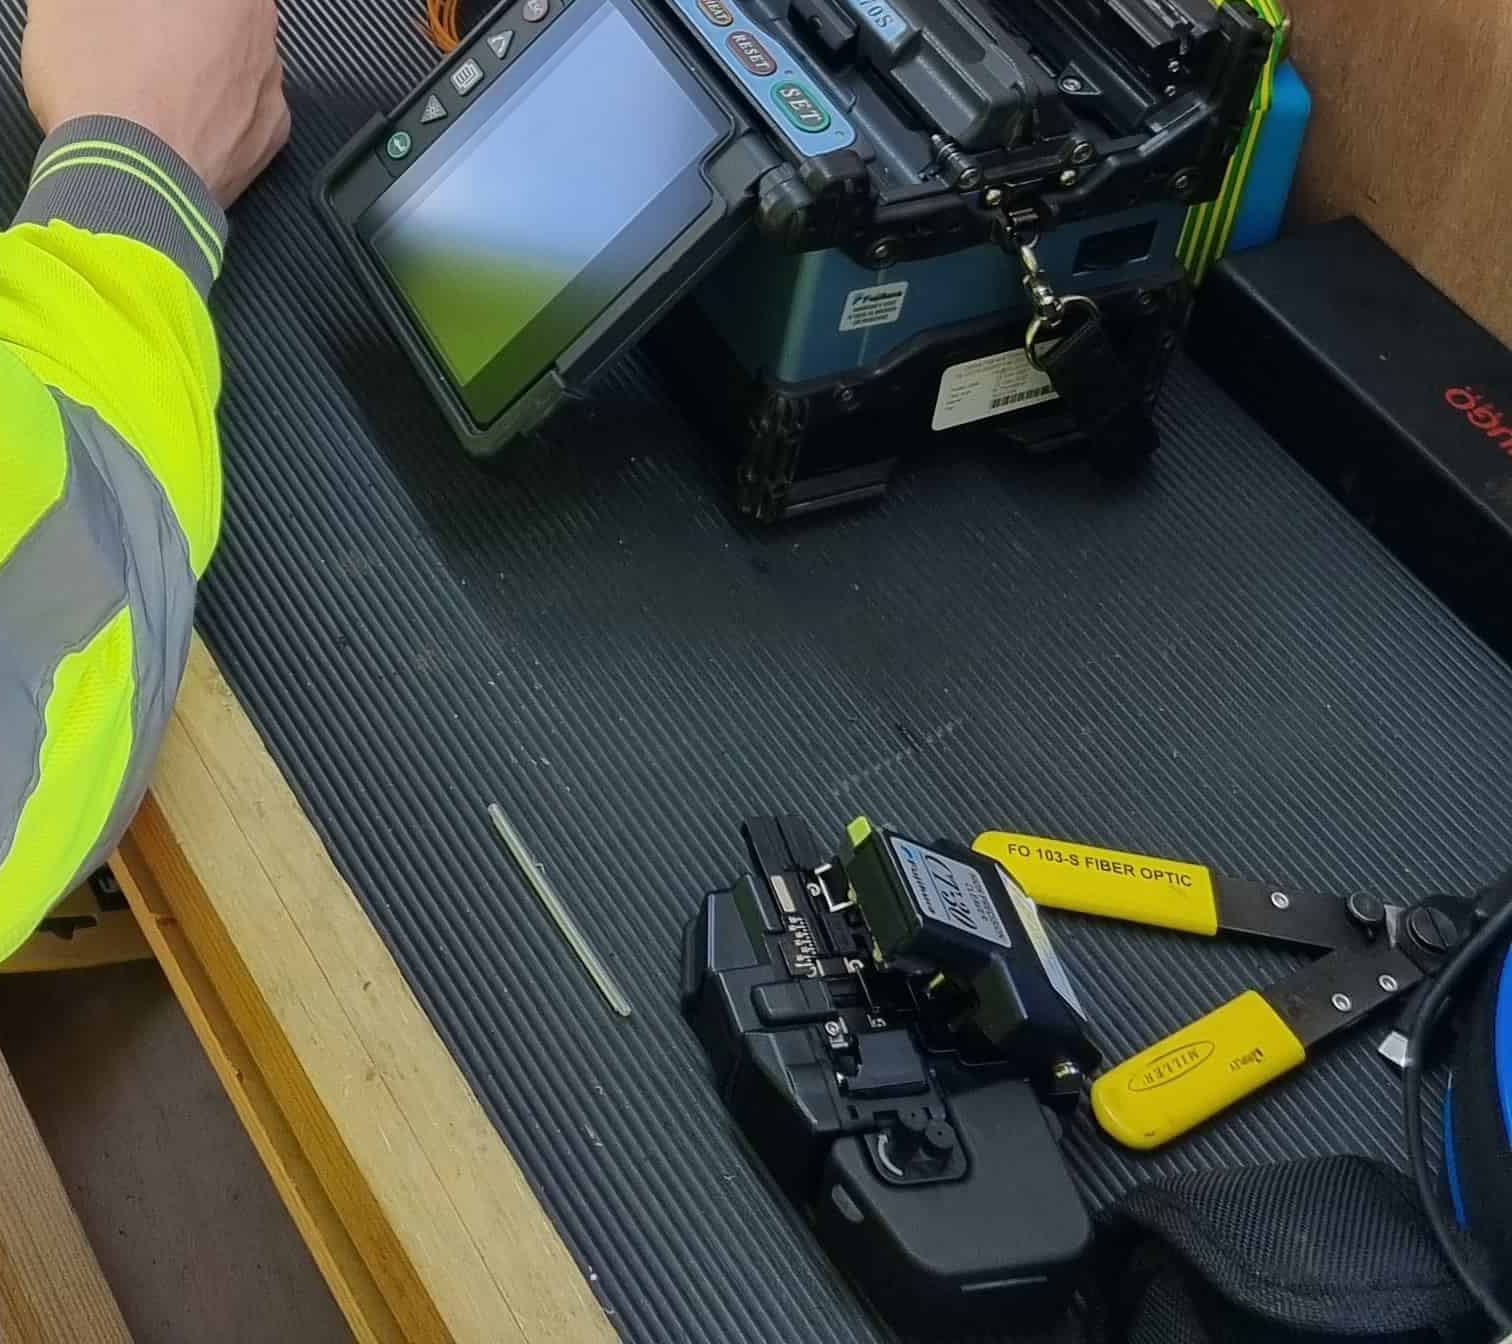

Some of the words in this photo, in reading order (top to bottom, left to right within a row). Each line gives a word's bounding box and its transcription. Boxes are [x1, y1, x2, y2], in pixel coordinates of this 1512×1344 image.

[732, 33, 771, 70] RESET
[779, 87, 824, 124] SET
[1007, 843, 1030, 857] FO
[1037, 848, 1080, 866] 103-S
[1085, 857, 1136, 877] FIBER
[1140, 867, 1193, 888] OPTIC
[1143, 1047, 1200, 1086] MILLER
